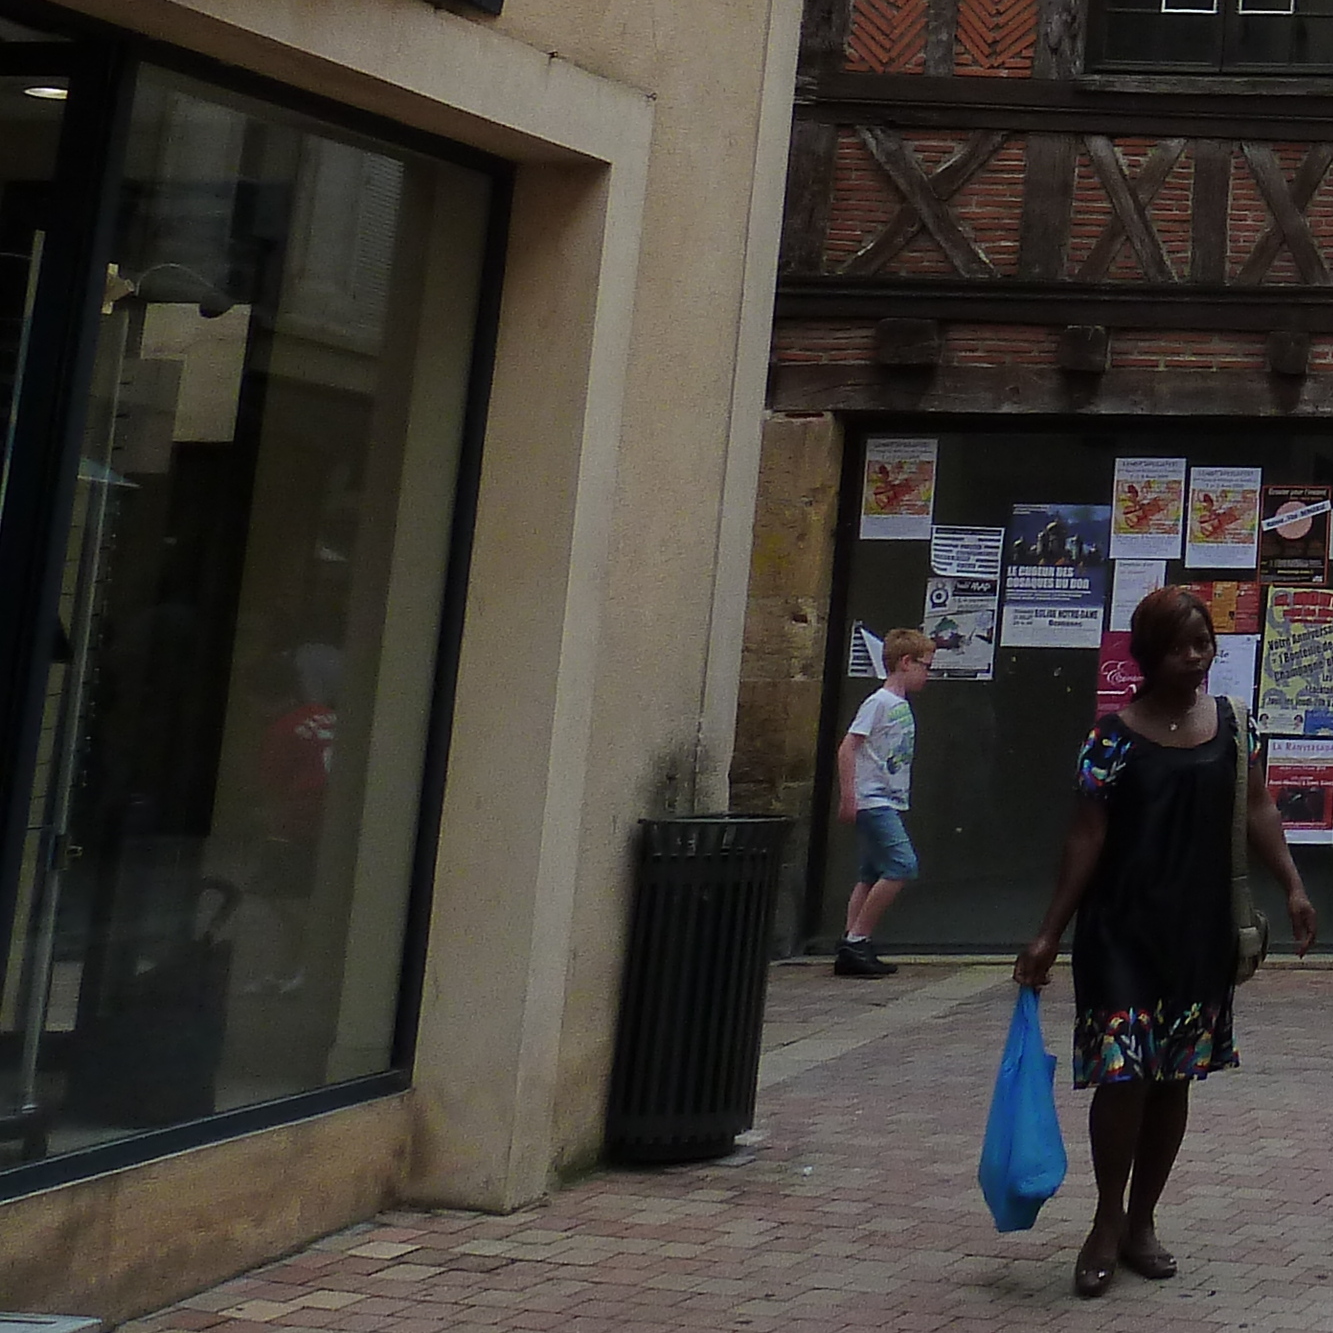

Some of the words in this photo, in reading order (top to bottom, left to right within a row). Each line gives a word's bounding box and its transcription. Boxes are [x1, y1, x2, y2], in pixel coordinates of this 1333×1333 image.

[1006, 566, 1018, 577] LE
[1055, 566, 1075, 578] DES
[1055, 578, 1069, 589] DU
[1069, 578, 1090, 590] DON
[1268, 637, 1291, 652] Votre
[1274, 659, 1324, 682] Champagne
